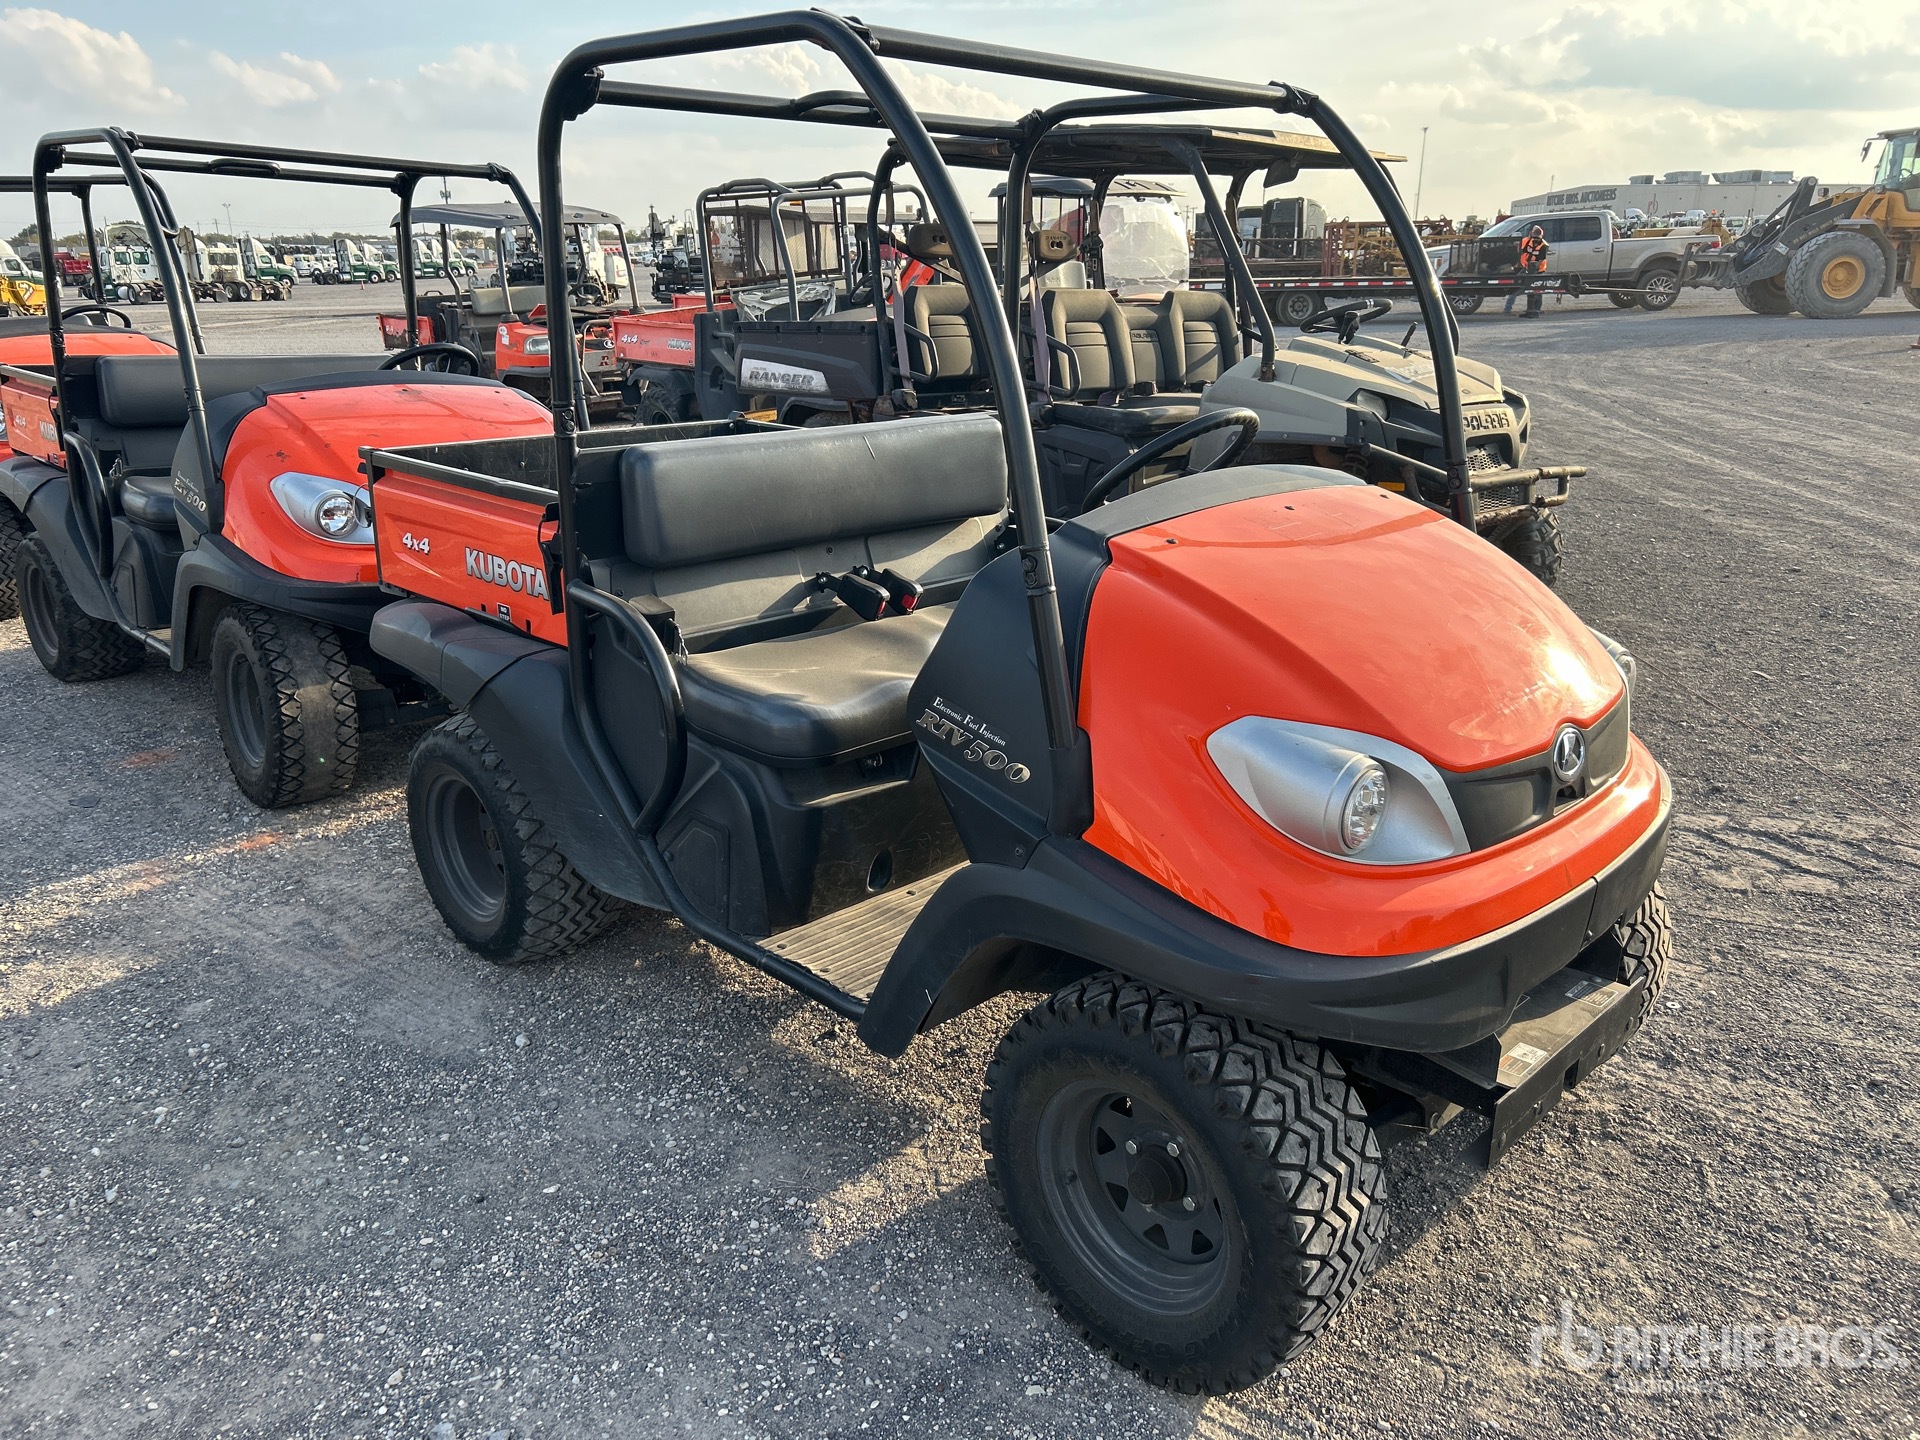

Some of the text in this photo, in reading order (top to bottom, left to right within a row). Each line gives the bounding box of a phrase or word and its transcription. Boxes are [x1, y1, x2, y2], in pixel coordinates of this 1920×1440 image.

[621, 334, 638, 344] 4x4
[749, 370, 815, 386] RANGER
[402, 532, 430, 554] 4x4
[465, 547, 550, 601] KUBOTA
[933, 696, 1006, 747] Electronic Fuel Injection
